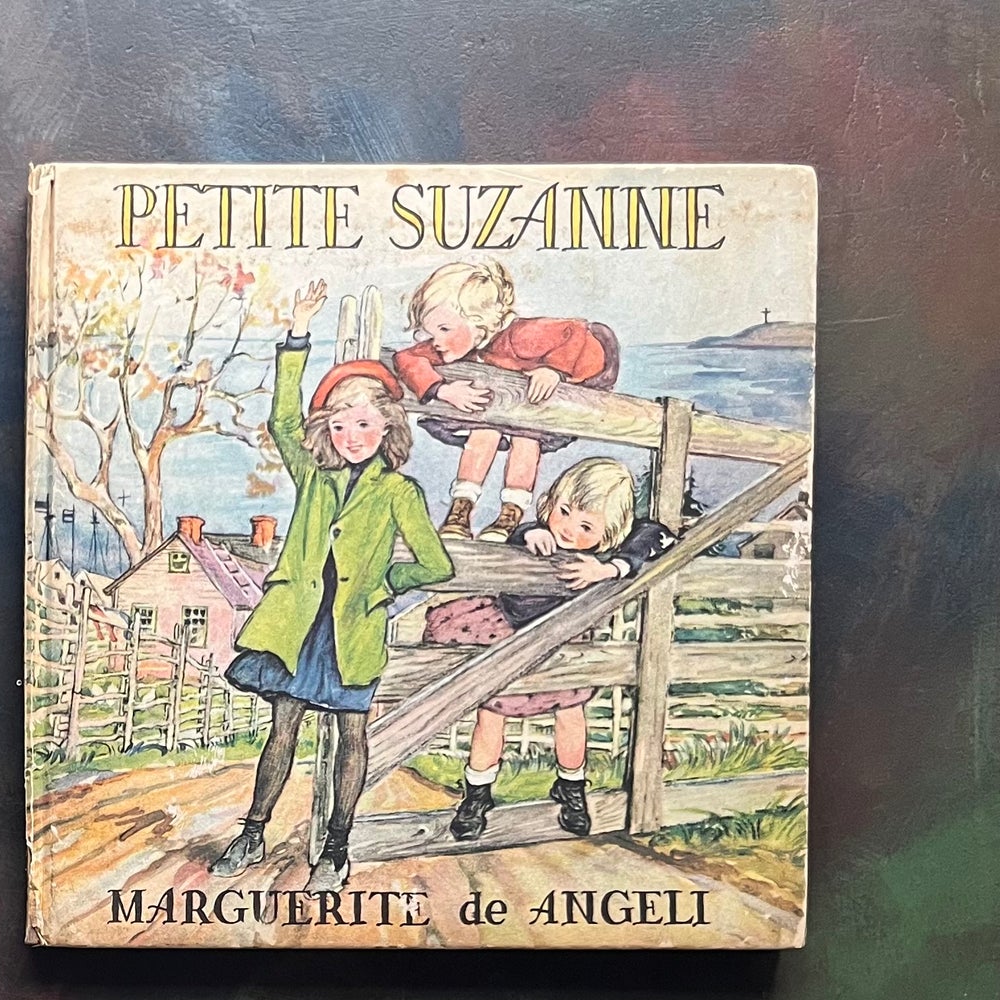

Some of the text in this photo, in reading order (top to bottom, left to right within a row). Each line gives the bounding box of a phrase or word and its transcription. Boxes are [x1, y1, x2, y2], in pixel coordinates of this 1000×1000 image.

[113, 182, 725, 251] PETITE SUZANNE
[107, 888, 711, 927] MARGUERITE de ANGELI
